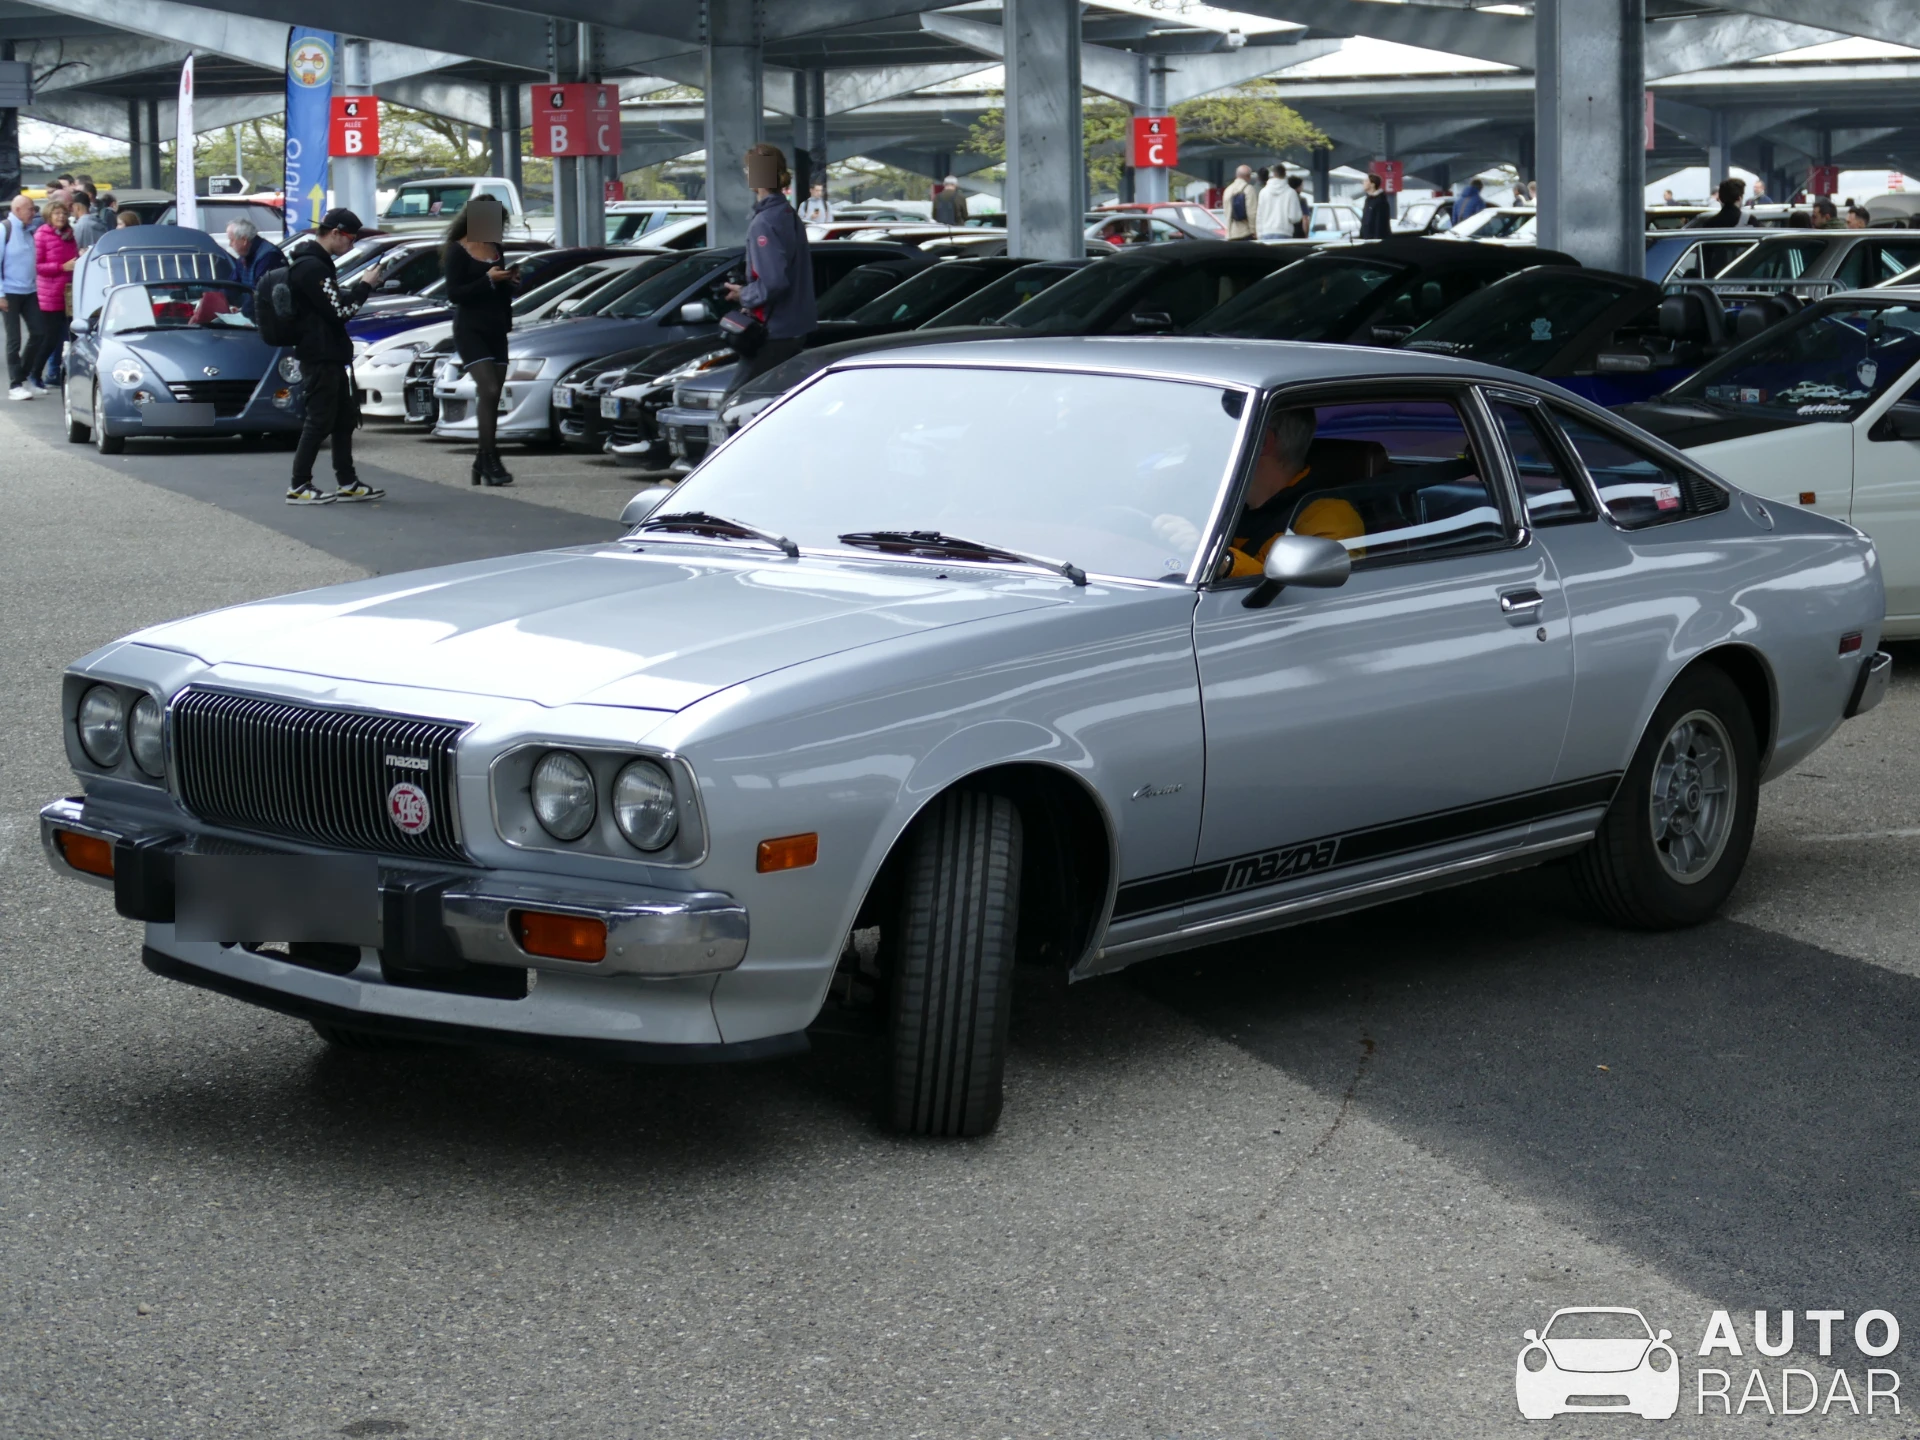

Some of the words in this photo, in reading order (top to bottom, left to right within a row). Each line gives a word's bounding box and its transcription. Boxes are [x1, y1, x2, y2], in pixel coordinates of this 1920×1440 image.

[552, 93, 562, 106] 4
[347, 103, 358, 116] 4
[1151, 123, 1159, 133] 4
[345, 130, 363, 154] B
[550, 125, 568, 153] B
[598, 124, 610, 152] C
[1149, 144, 1164, 165] C
[1385, 179, 1393, 192] E
